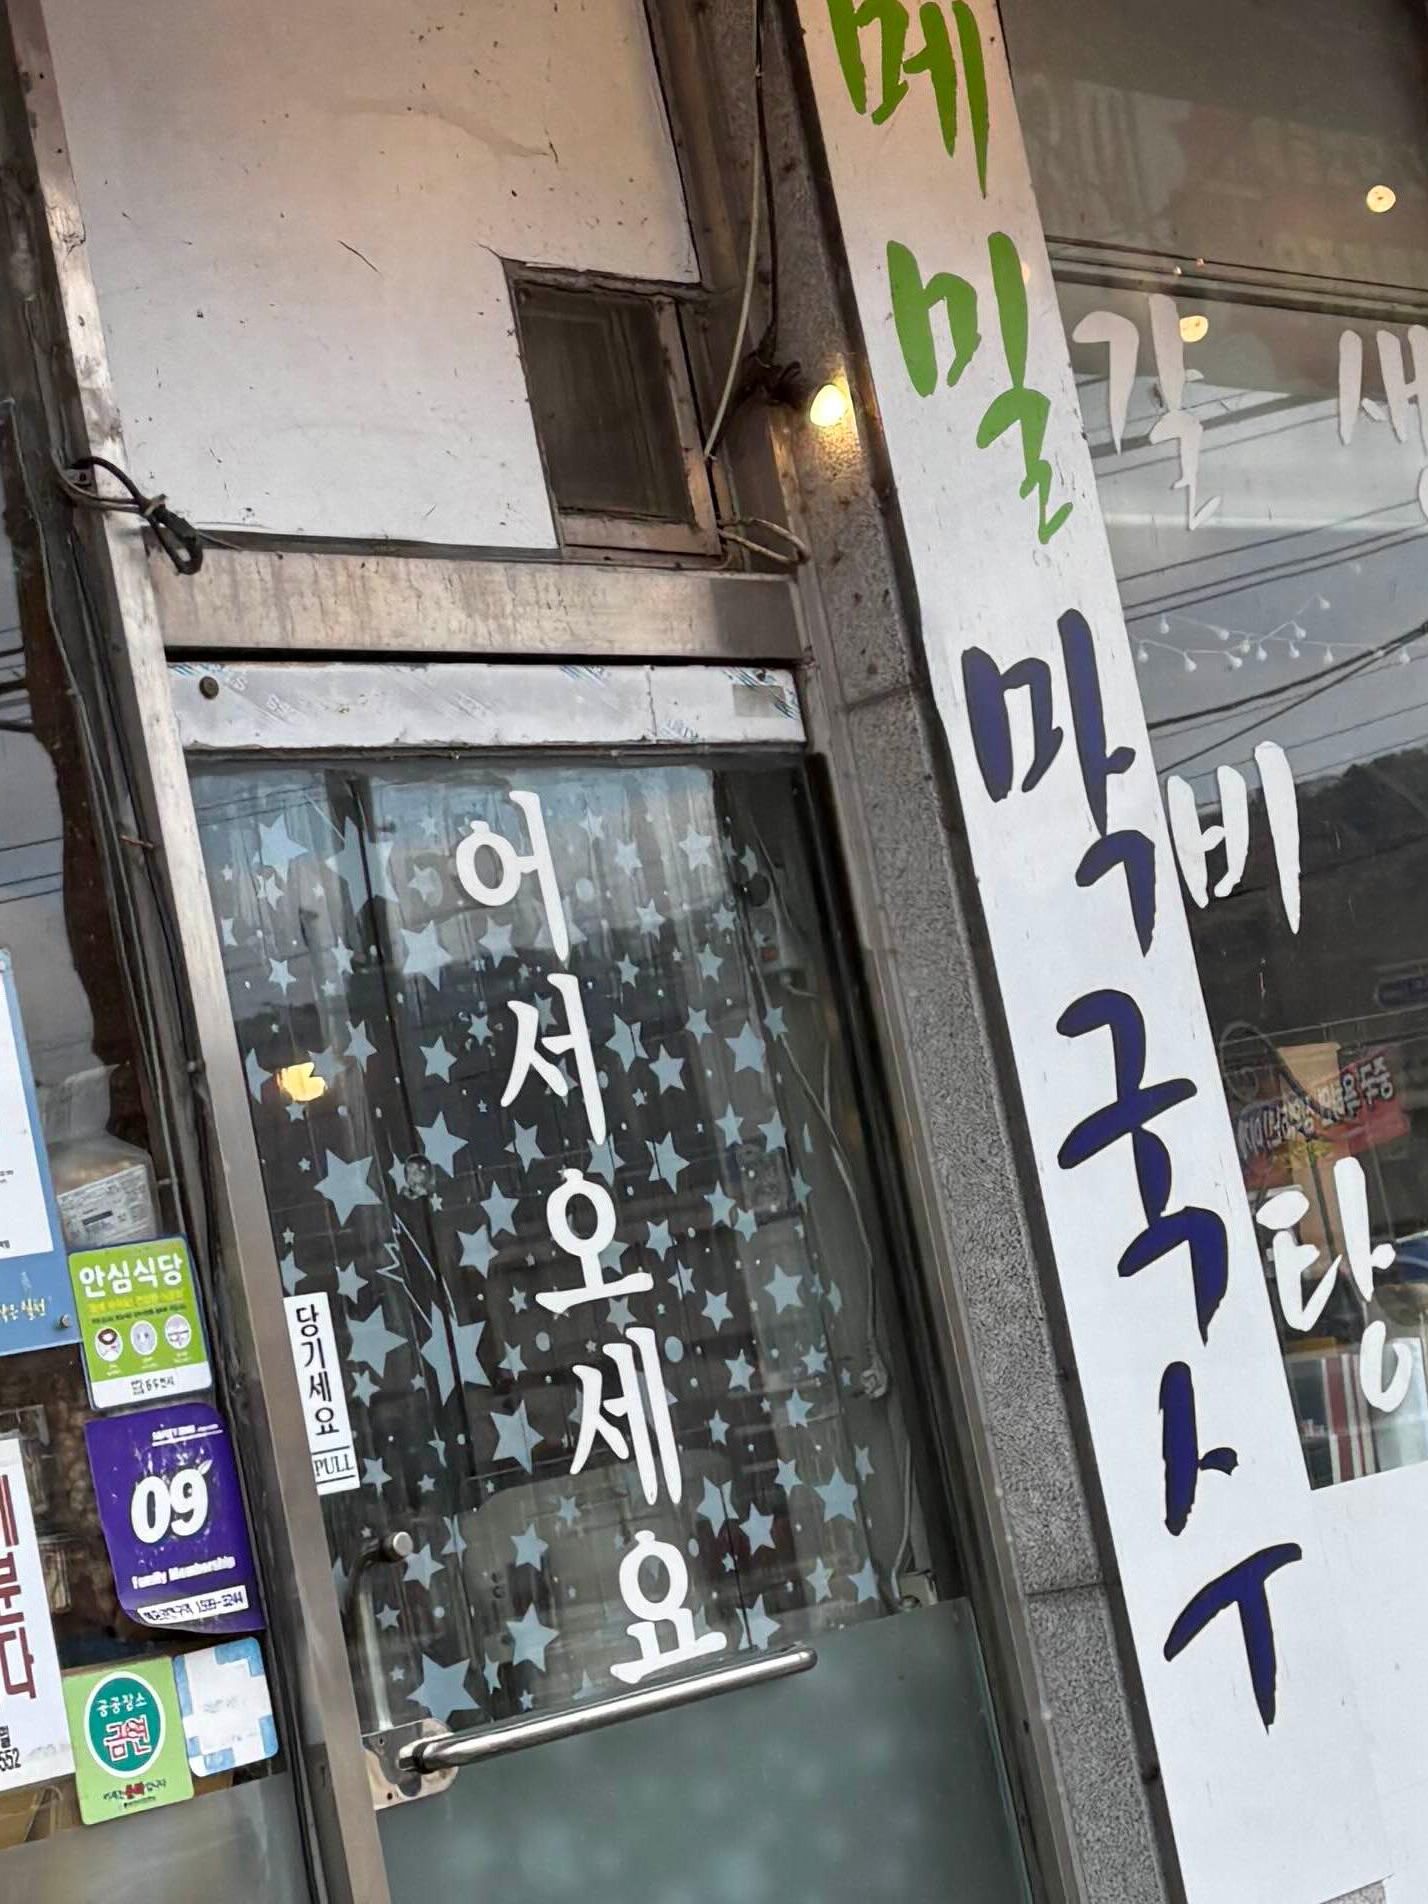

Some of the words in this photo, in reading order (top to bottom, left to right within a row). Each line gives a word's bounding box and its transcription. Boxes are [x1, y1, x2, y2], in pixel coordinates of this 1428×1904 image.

[959, 607, 1305, 1736] 막국수
[79, 1252, 184, 1299] 안심식당
[295, 1303, 340, 1437] 당기세요
[313, 1453, 355, 1477] PULL
[96, 1692, 149, 1718] 공공장소
[103, 1714, 152, 1763] 금연
